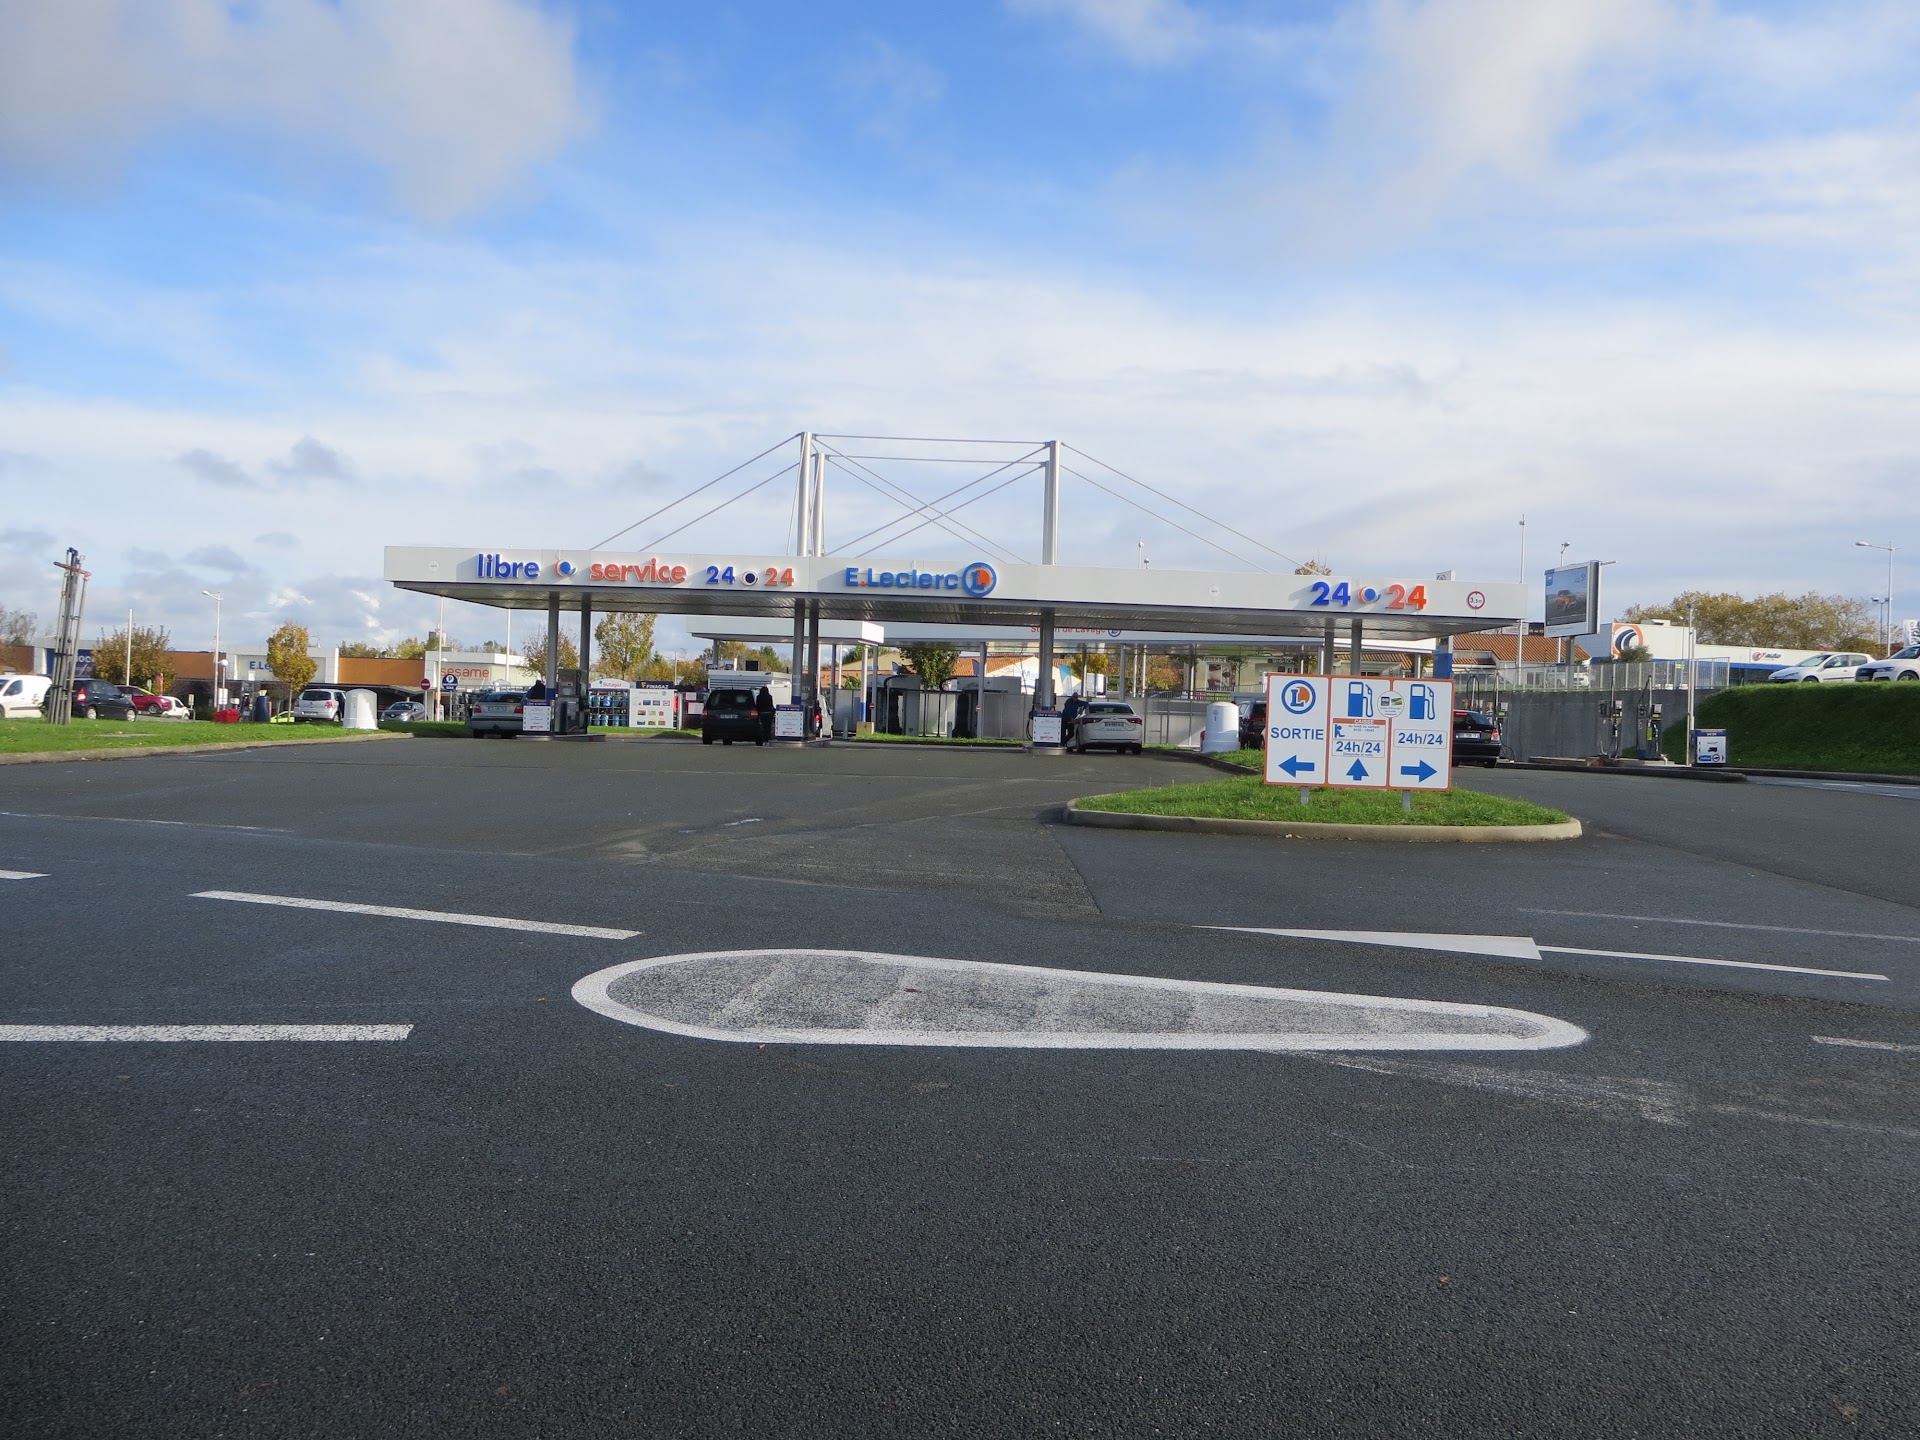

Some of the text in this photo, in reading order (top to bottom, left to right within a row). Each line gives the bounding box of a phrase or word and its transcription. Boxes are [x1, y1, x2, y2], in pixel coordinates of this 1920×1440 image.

[478, 553, 795, 586] libre service 24 24
[845, 567, 959, 589] E.Leclerc
[1310, 581, 1427, 610] 24 24
[440, 667, 490, 678] sesame
[1270, 727, 1324, 740] SORTIE
[1397, 732, 1444, 745] 24h/24
[1335, 740, 1381, 753] 24h/24
